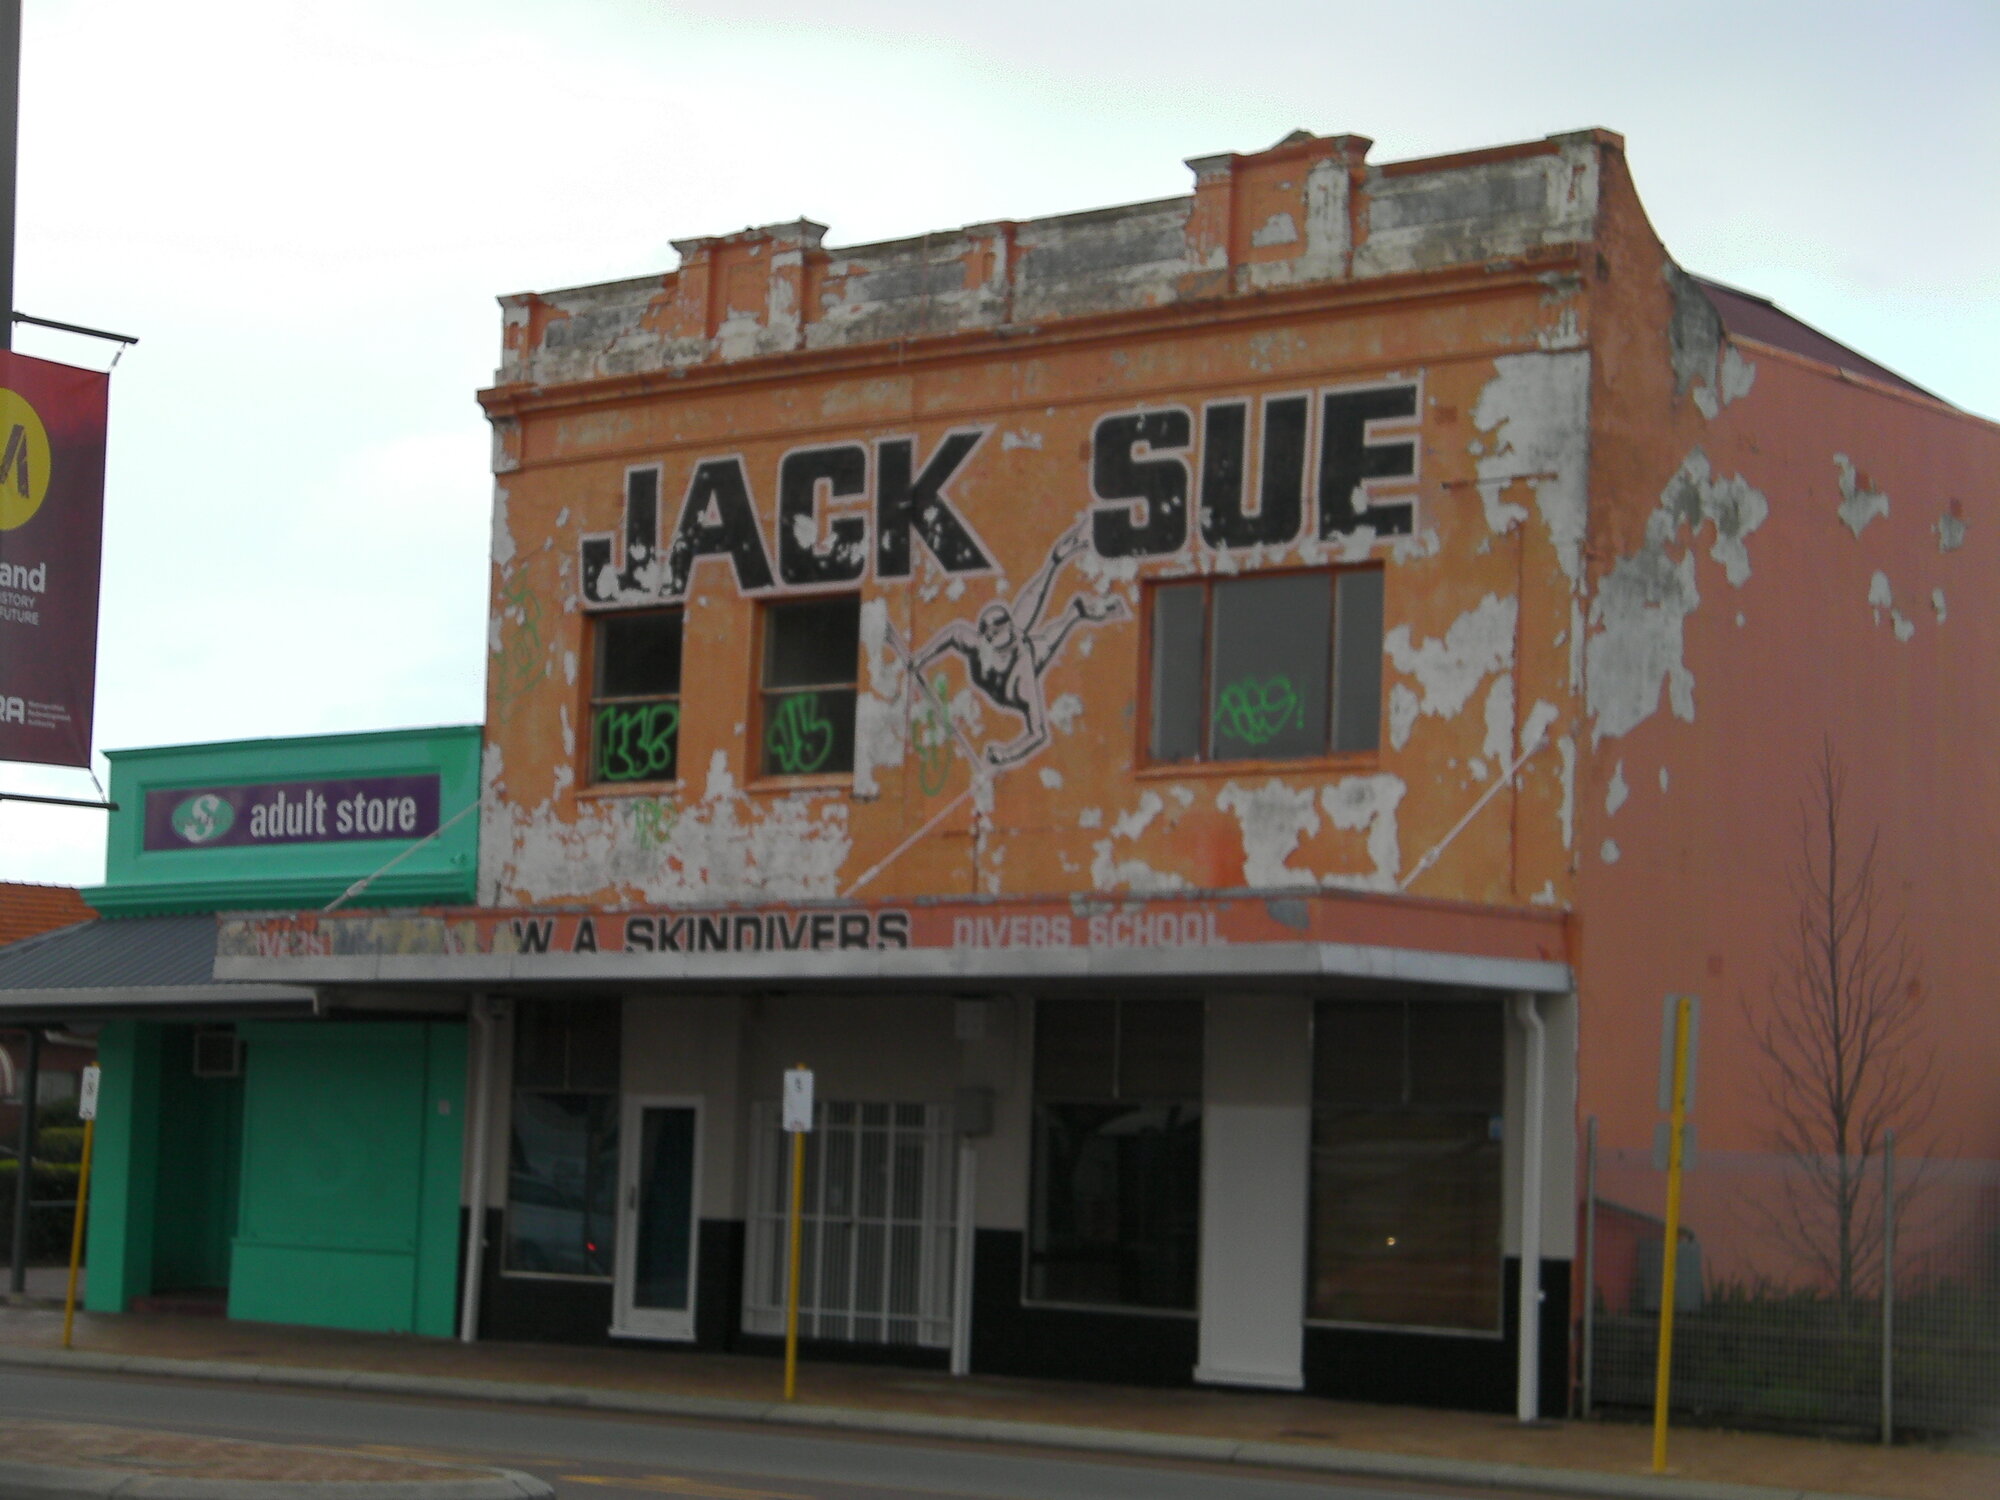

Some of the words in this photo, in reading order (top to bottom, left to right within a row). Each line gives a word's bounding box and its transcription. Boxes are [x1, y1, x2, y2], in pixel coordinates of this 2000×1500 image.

[577, 424, 999, 607] JACK
[1092, 382, 1420, 558] SUE
[250, 788, 327, 839] adult
[336, 791, 417, 834] store
[571, 916, 597, 953] A
[624, 910, 911, 952] SKINDIVERS
[953, 914, 1072, 948] DIVERS
[1089, 908, 1227, 946] SCHOOL
